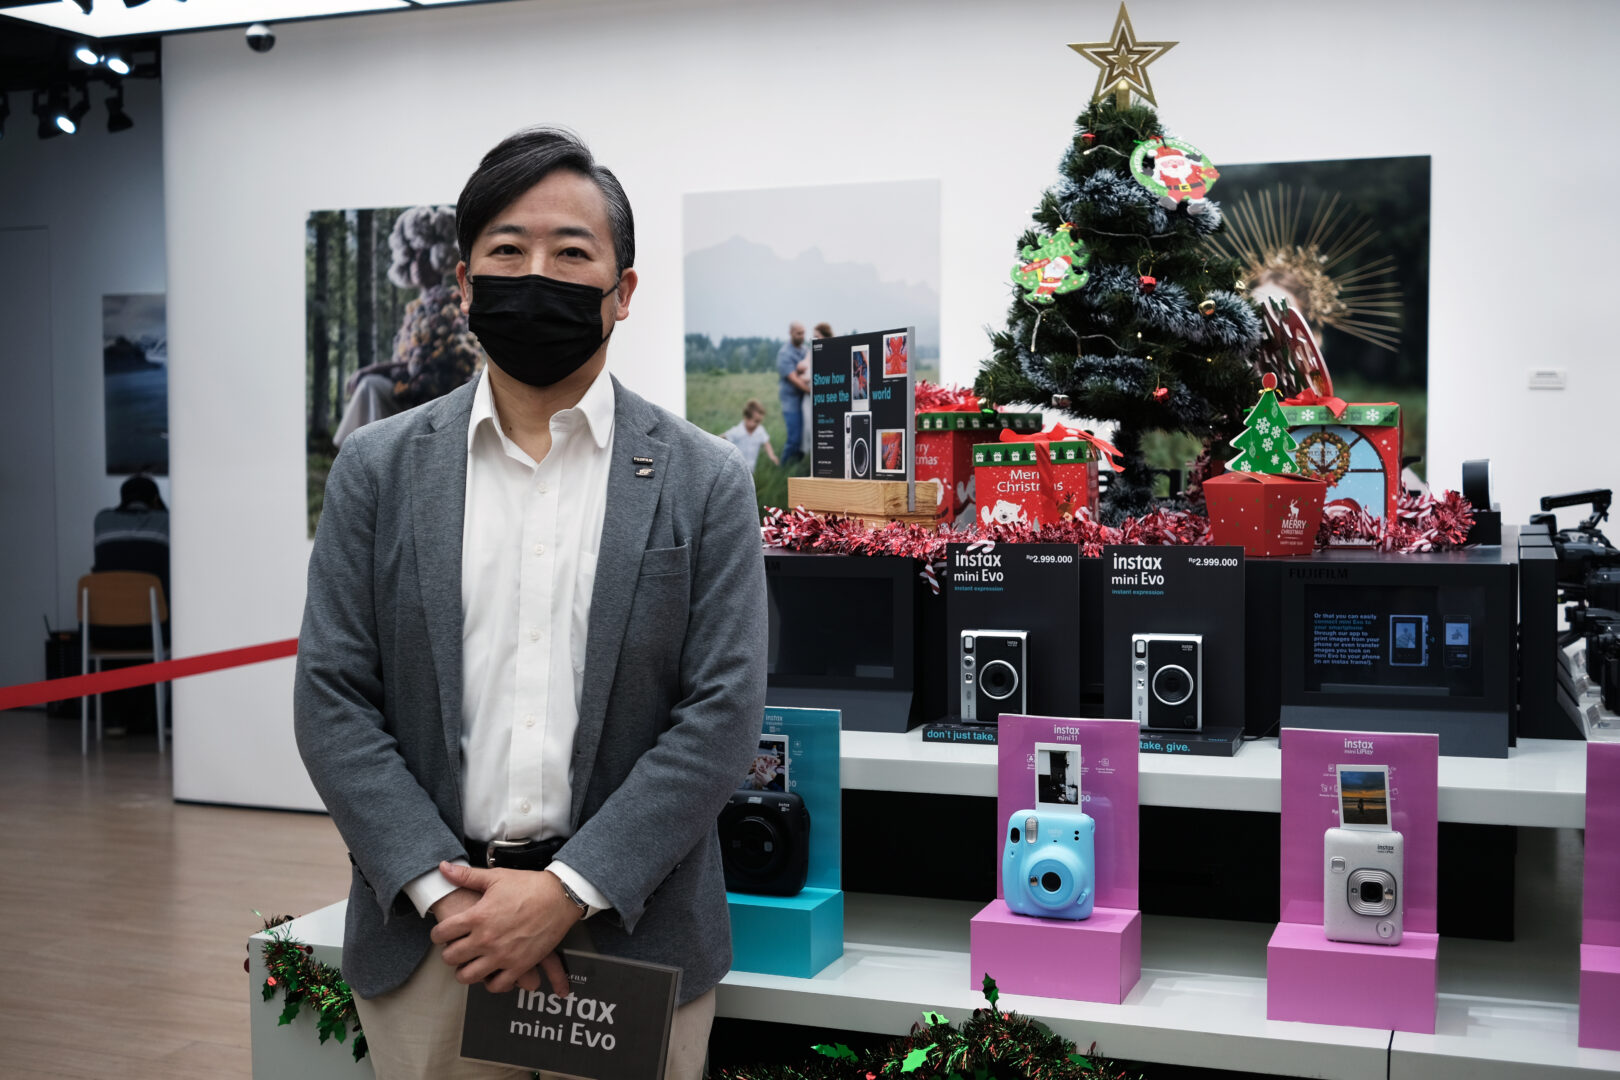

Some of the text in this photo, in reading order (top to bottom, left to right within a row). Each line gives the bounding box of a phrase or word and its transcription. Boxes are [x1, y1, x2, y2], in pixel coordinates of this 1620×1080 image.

[813, 372, 845, 386] Show how
[813, 387, 892, 406] you see the world
[1281, 519, 1307, 529] MERRY
[955, 550, 1002, 567] instax
[1113, 553, 1162, 570] instax
[953, 569, 1004, 582] mini Evo
[1111, 572, 1165, 585] mini Evo
[1289, 568, 1349, 578] FUJIFILM
[927, 730, 996, 742] don't just take,
[1053, 724, 1080, 735] instax
[1140, 740, 1191, 753] take, give.
[1344, 738, 1373, 749] instax
[517, 988, 617, 1025] instax
[509, 1019, 616, 1051] mini Evo
